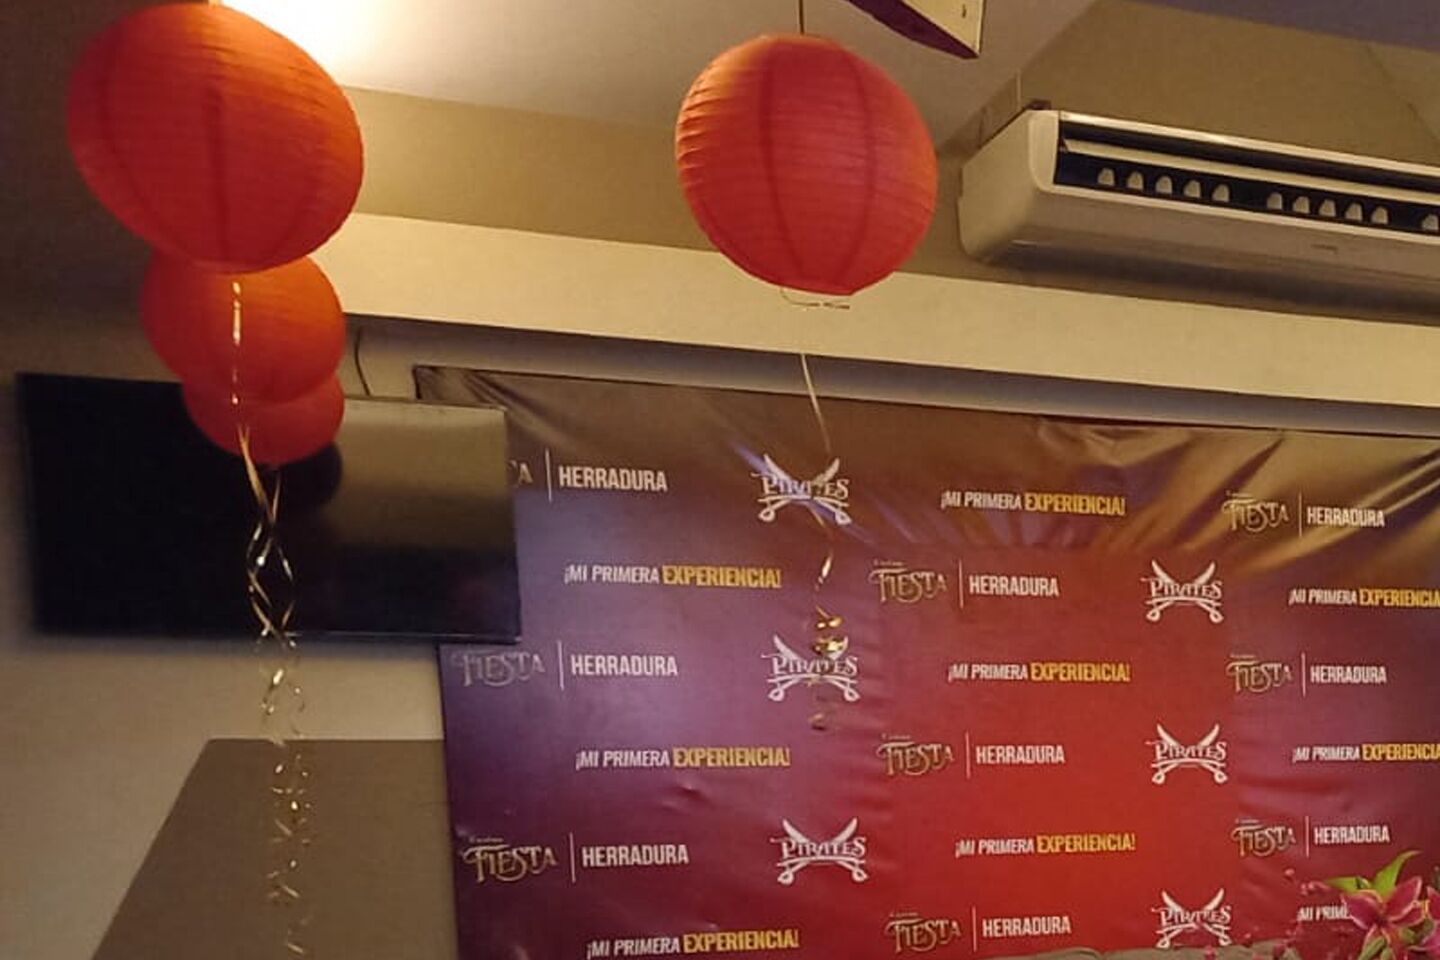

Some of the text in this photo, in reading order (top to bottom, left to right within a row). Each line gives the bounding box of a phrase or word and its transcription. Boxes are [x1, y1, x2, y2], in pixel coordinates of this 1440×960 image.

[559, 465, 668, 492] HERRADURA
[964, 491, 1022, 510] PRIMERA
[1025, 492, 1126, 516] EXPERIENCIA!
[1221, 497, 1385, 533] FIESTA HERRADURA
[592, 566, 659, 585] PRIMERA
[662, 565, 782, 589] EXPERIENCIA!
[868, 569, 1059, 603] FIESTA HERRADURA
[1308, 588, 1357, 606] PRIMERA
[449, 650, 678, 688] FIESTA HERRADURA
[971, 662, 1028, 681] PRIMERA
[1030, 662, 1131, 682] EXPERIENCIA!
[1226, 661, 1387, 694] FIESTA HERRADURA
[602, 750, 670, 768] PRIMERA
[673, 746, 791, 768] EXPERIENCIA!
[876, 741, 1065, 776] FIESTA HERRADURA
[1312, 745, 1361, 761] PRIMERA
[978, 838, 1035, 856] PRIMERA
[1037, 833, 1136, 853] EXPERIENCIA!
[1231, 823, 1390, 857] FIESTA HERRADURA
[463, 844, 689, 883] FIESTA HERRADURA
[613, 937, 680, 957] PRIMERA
[683, 929, 800, 954] EXPERIENCIA!
[884, 915, 1072, 952] FIESTA HERRADURA
